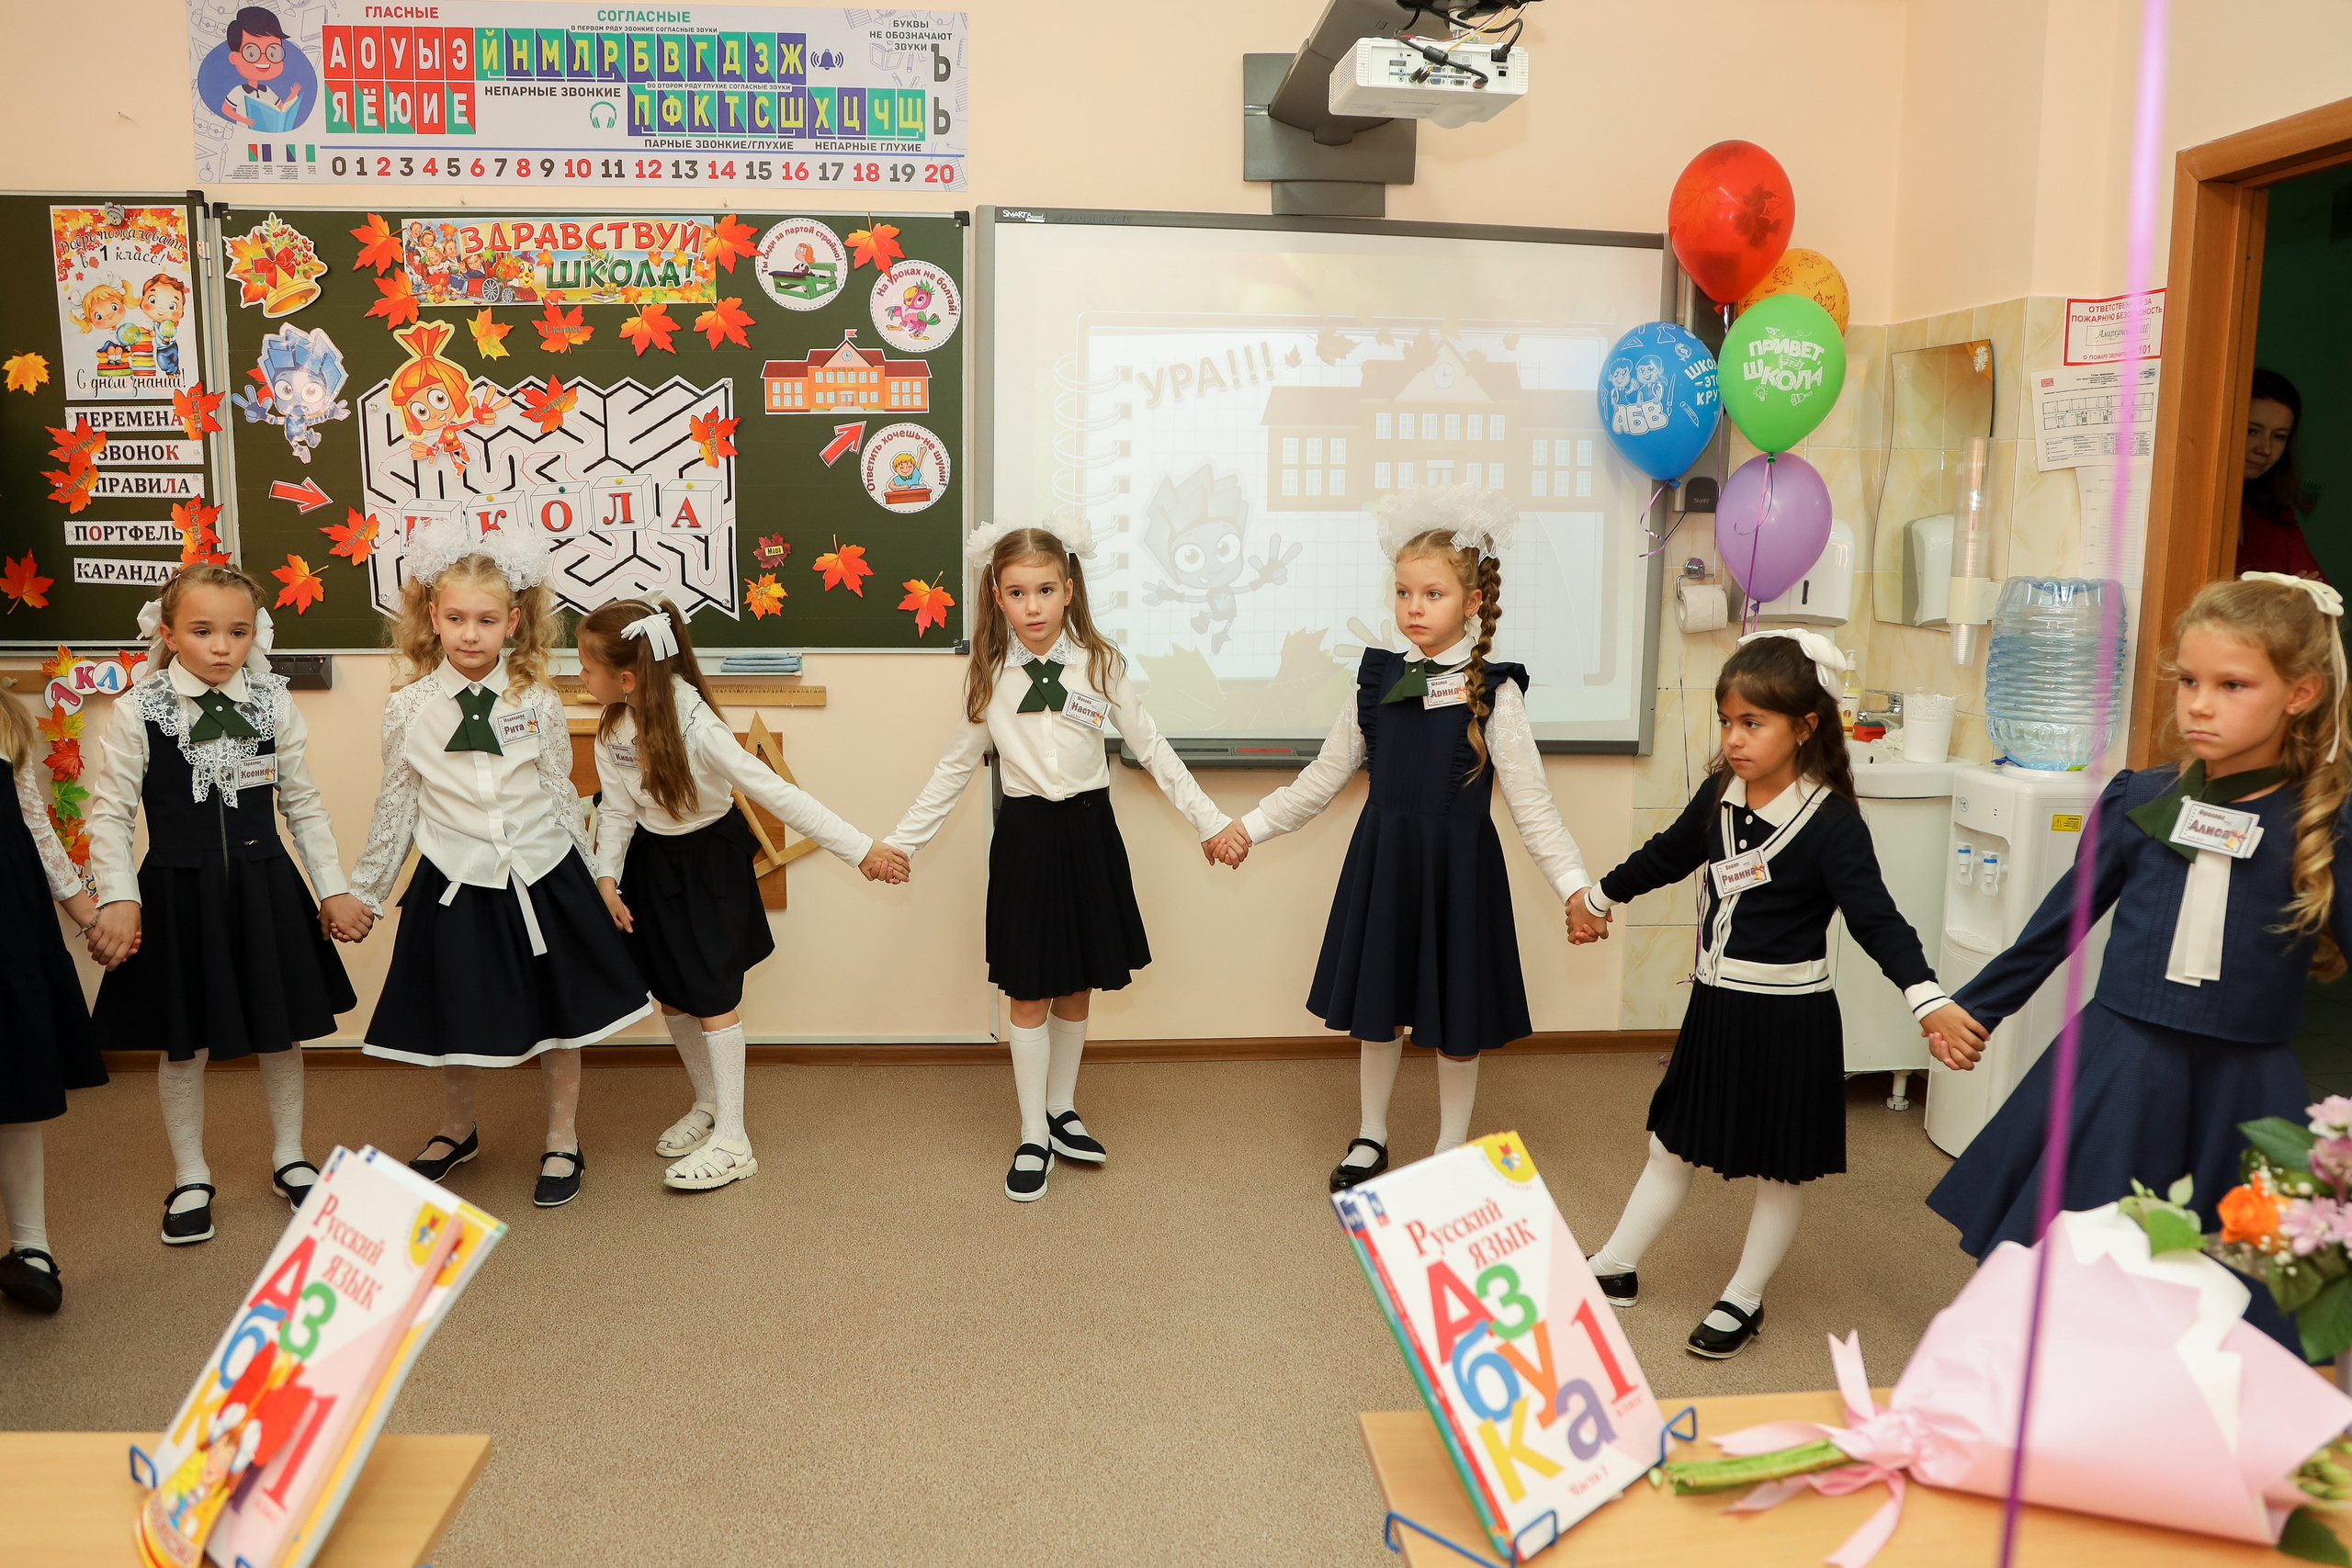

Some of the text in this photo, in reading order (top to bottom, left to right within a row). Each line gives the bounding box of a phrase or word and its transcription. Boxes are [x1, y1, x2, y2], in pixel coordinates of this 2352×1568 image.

[365, 6, 439, 19] ГЛАСНЫЕ
[597, 9, 691, 23] СОГЛАСНЫЕ
[893, 19, 929, 28] БУКВЫ
[869, 30, 953, 40] НЕ ОБОЗНАЧАЮТ
[894, 42, 927, 51] ЗВУКИ
[931, 43, 951, 82] Ъ
[484, 85, 621, 98] НЕПАРНЫЕ ЗВОНКИЕ
[933, 96, 951, 135] Ь
[644, 139, 794, 151] ПАРНЫЕ ЗВОНКИЕ/ГЛУХИЕ
[815, 141, 922, 152] НЕПАРНЫЕ ГЛУХИЕ
[332, 157, 347, 176] 0
[356, 157, 368, 176] 1
[377, 157, 391, 176] 2
[400, 157, 414, 176] 3
[423, 157, 438, 176] 4
[447, 157, 461, 177] 5
[470, 157, 485, 177] 6
[494, 157, 508, 177] 7
[516, 157, 532, 177] 8
[540, 157, 555, 177] 9
[564, 158, 592, 178] 10
[601, 159, 625, 178] 11
[635, 159, 662, 179] 12
[672, 160, 699, 179] 13
[707, 160, 736, 180] 14
[745, 161, 773, 180] 15
[782, 161, 809, 181] 16
[819, 162, 844, 181] 17
[853, 162, 880, 182] 18
[889, 163, 916, 182] 19
[924, 164, 955, 184] 20
[1002, 209, 1028, 220] SMART
[58, 228, 185, 255] Добро пожаловать
[762, 261, 768, 274] Ты
[775, 231, 785, 241] за
[785, 225, 815, 235] партой
[815, 230, 843, 262] стройно!
[81, 245, 165, 268] в 1 класс!
[546, 258, 693, 289] ШКОЛА!
[876, 282, 888, 298] На
[923, 269, 936, 280] не
[936, 276, 957, 317] болтай!
[2143, 298, 2153, 306] ЗА
[2071, 306, 2163, 323] ПОЖАРНУЮ БЕЗОСНОСТЬ
[542, 324, 583, 335] 1 класс
[2138, 344, 2151, 355] 101
[76, 368, 187, 398] С днём знаний!
[1136, 341, 1274, 407] УРА!!!
[1743, 358, 1824, 392] ШКОЛА
[533, 392, 569, 418] 1 класс
[75, 411, 184, 428] ПЕРЕМЕНА
[191, 401, 203, 433] класс
[1612, 400, 1669, 435] АБВ
[60, 434, 97, 459] 1 класс
[97, 444, 179, 461] ЗВОНОК
[707, 425, 719, 458] класс
[866, 443, 883, 491] Ответить
[933, 449, 948, 487] шуми!
[59, 469, 90, 501] 1 класс
[95, 477, 191, 494] ПРАВИЛА
[74, 525, 184, 542] ПОРТФЕЛЬ
[190, 513, 202, 545] класс
[339, 522, 370, 553] 1 класс
[77, 562, 180, 583] КАРАНДА
[1430, 687, 1459, 698] Арина
[1070, 701, 1099, 718] Настя
[504, 724, 525, 735] Рита
[241, 768, 269, 779] Ксения
[2188, 819, 2233, 840] Алиса
[1721, 866, 1757, 885] Рианна
[312, 1193, 386, 1268] Русский
[1403, 1196, 1505, 1259] Русский
[1570, 1297, 1640, 1405] 1
[263, 1393, 339, 1512] 1
